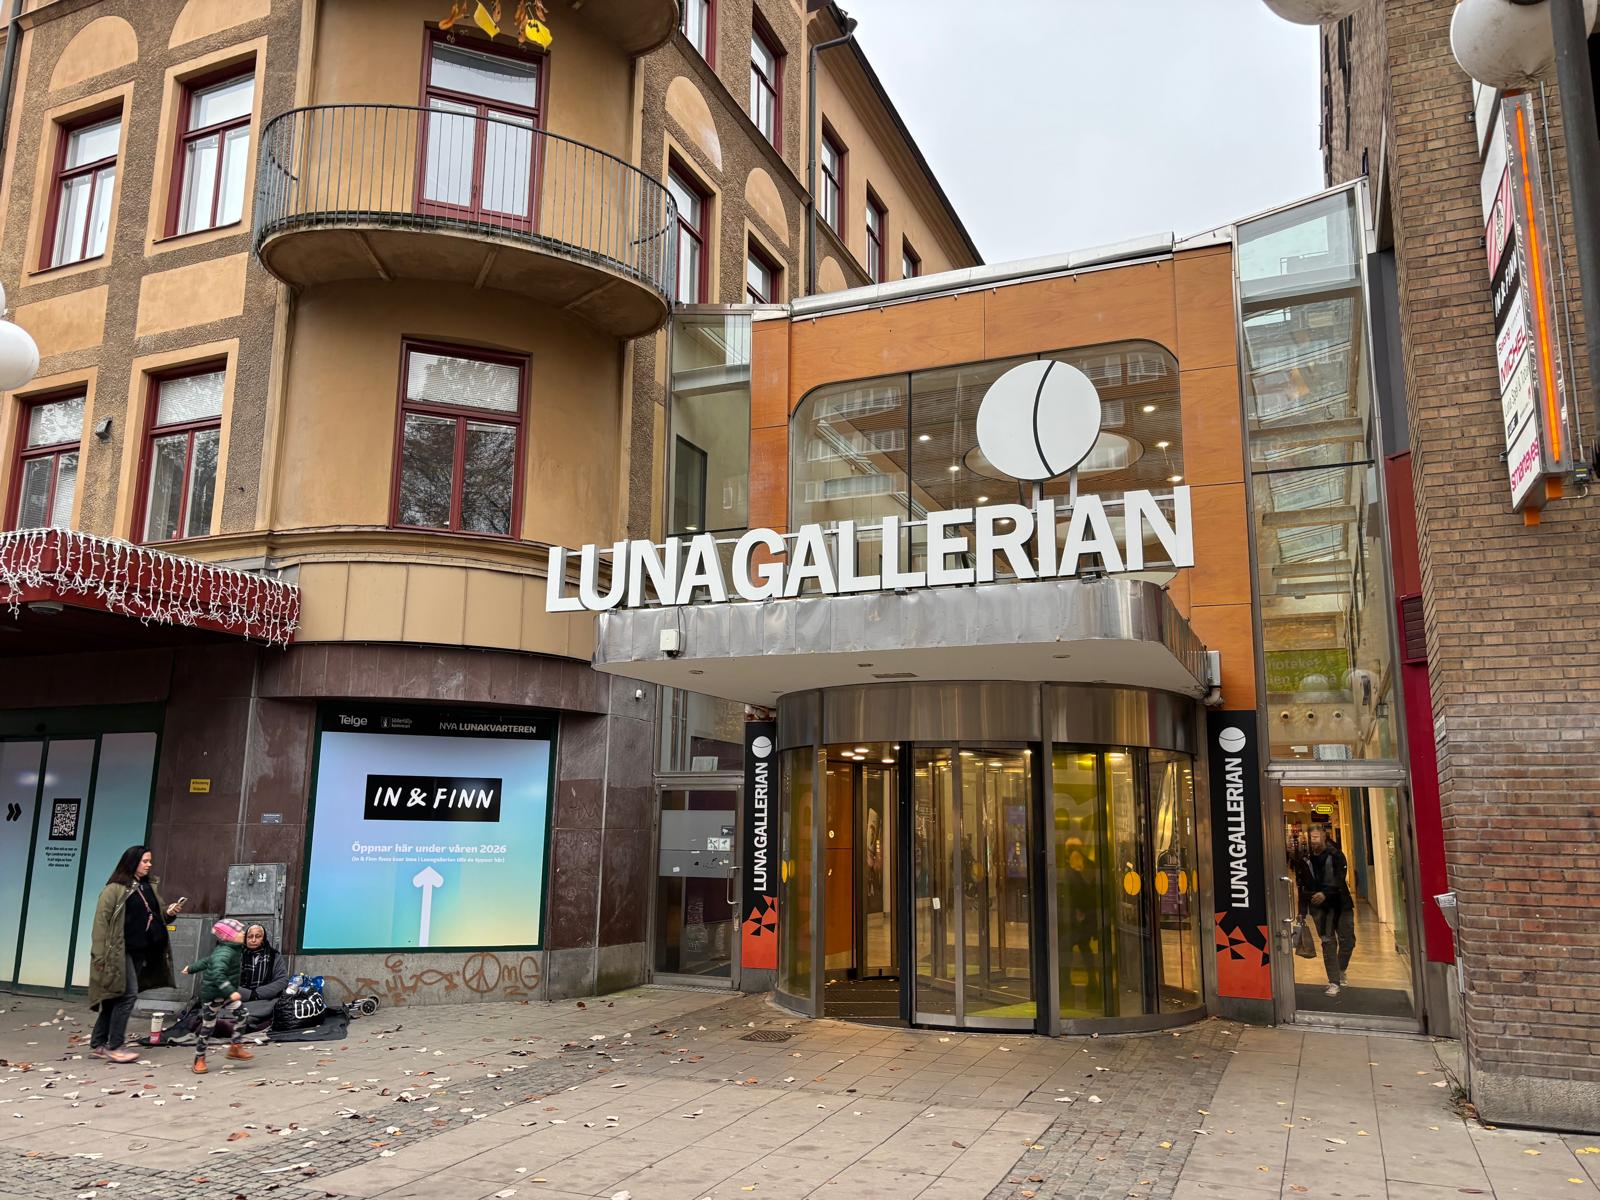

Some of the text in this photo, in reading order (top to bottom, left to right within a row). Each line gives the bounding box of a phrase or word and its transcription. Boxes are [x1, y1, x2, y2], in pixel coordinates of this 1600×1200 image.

[1500, 325, 1527, 386] MICHEL
[545, 485, 1194, 612] LUNAGALLERIAN
[338, 714, 368, 727] Telge
[439, 721, 537, 734] NYA LUNAKVARTEREN
[373, 786, 494, 809] IN & FINN
[351, 840, 507, 854] Öppnar här under våren 2026
[753, 762, 769, 891] LUNAGALLERIAN
[1225, 758, 1249, 908] LUNAGALLERIAN
